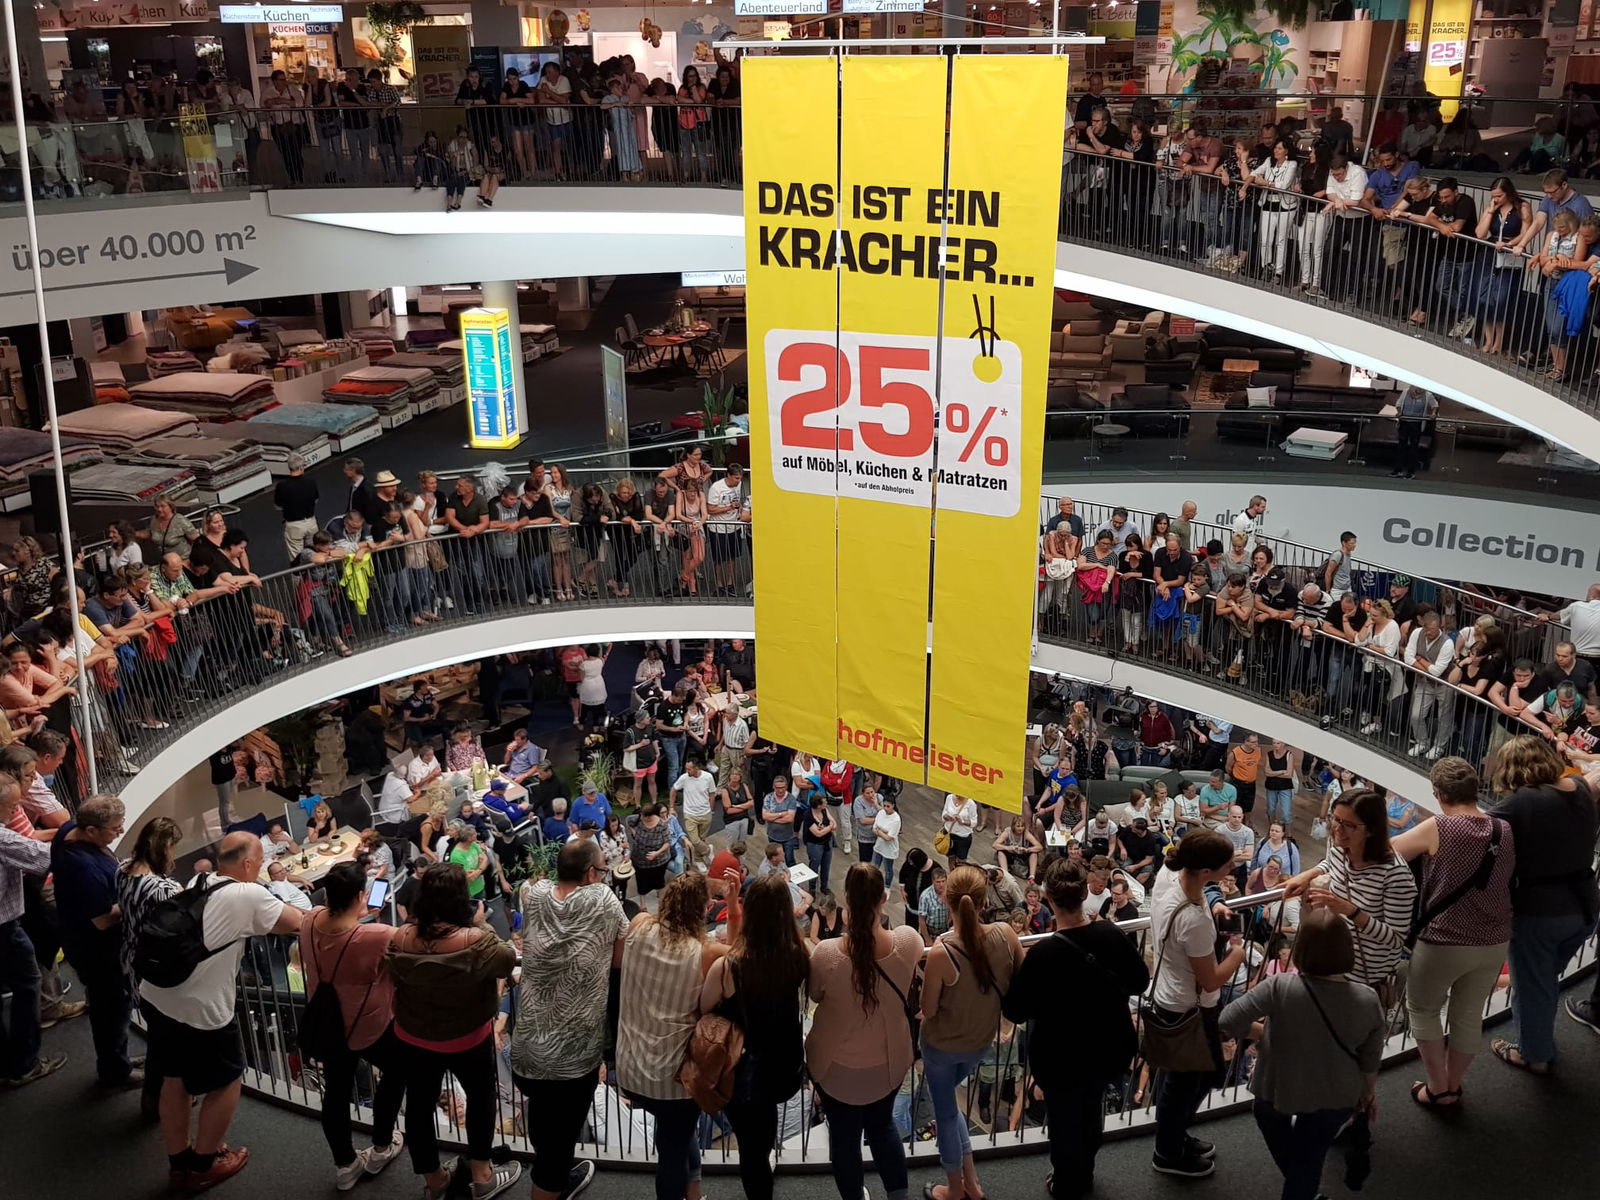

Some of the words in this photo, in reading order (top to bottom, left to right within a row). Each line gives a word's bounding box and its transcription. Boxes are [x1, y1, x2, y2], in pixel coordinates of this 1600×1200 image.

[262, 10, 310, 21] Küchen
[739, 3, 824, 13] Abenteuerland
[272, 25, 305, 34] KÜCHEN
[306, 24, 330, 33] STORE
[758, 180, 834, 218] DAS
[852, 184, 911, 222] IST
[927, 188, 1000, 228] EIN
[12, 243, 91, 272] über
[100, 228, 206, 262] 40.000
[215, 224, 257, 252] m²
[758, 225, 1034, 288] KRACHER...
[782, 456, 803, 470] auf
[806, 456, 853, 477] Möbel,
[856, 460, 908, 480] Küchen
[912, 467, 924, 482] &
[928, 467, 1008, 491] Matratzen
[868, 482, 881, 491] den
[881, 483, 915, 494] Abholpreis
[1383, 517, 1586, 570] Collection
[836, 717, 1004, 785] hofmeister
